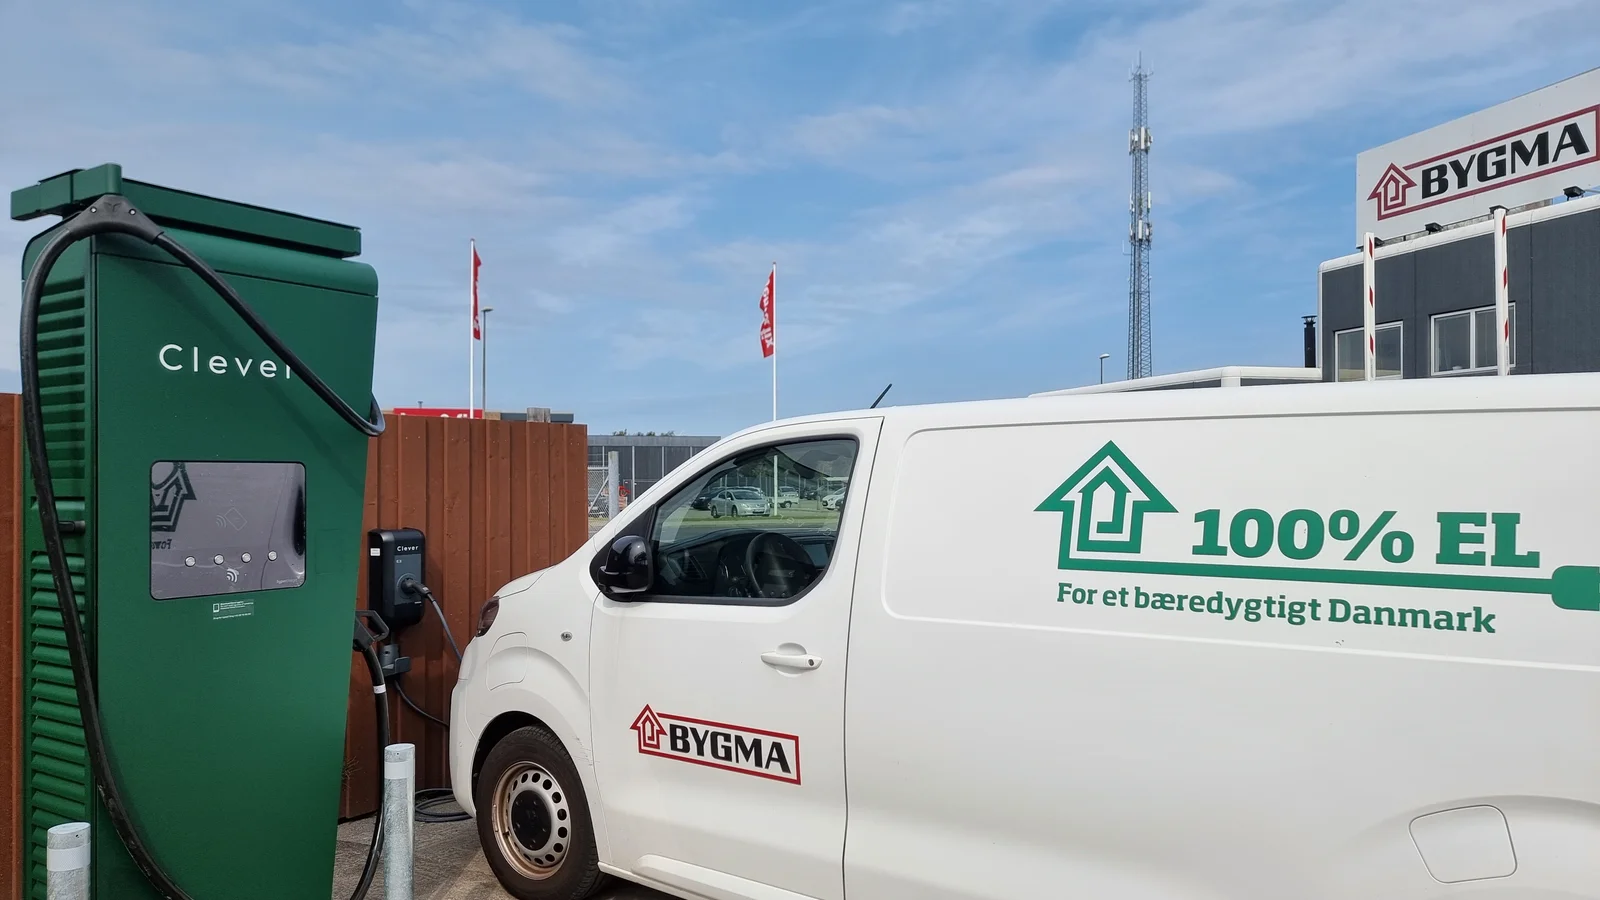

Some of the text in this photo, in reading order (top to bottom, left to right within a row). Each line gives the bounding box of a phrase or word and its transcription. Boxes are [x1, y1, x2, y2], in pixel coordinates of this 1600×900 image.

[1421, 122, 1590, 199] BYGMA
[1192, 508, 1540, 568] 100% EL
[1057, 583, 1496, 633] For et bæredygtigt Danmark
[669, 723, 792, 774] BYGMA
